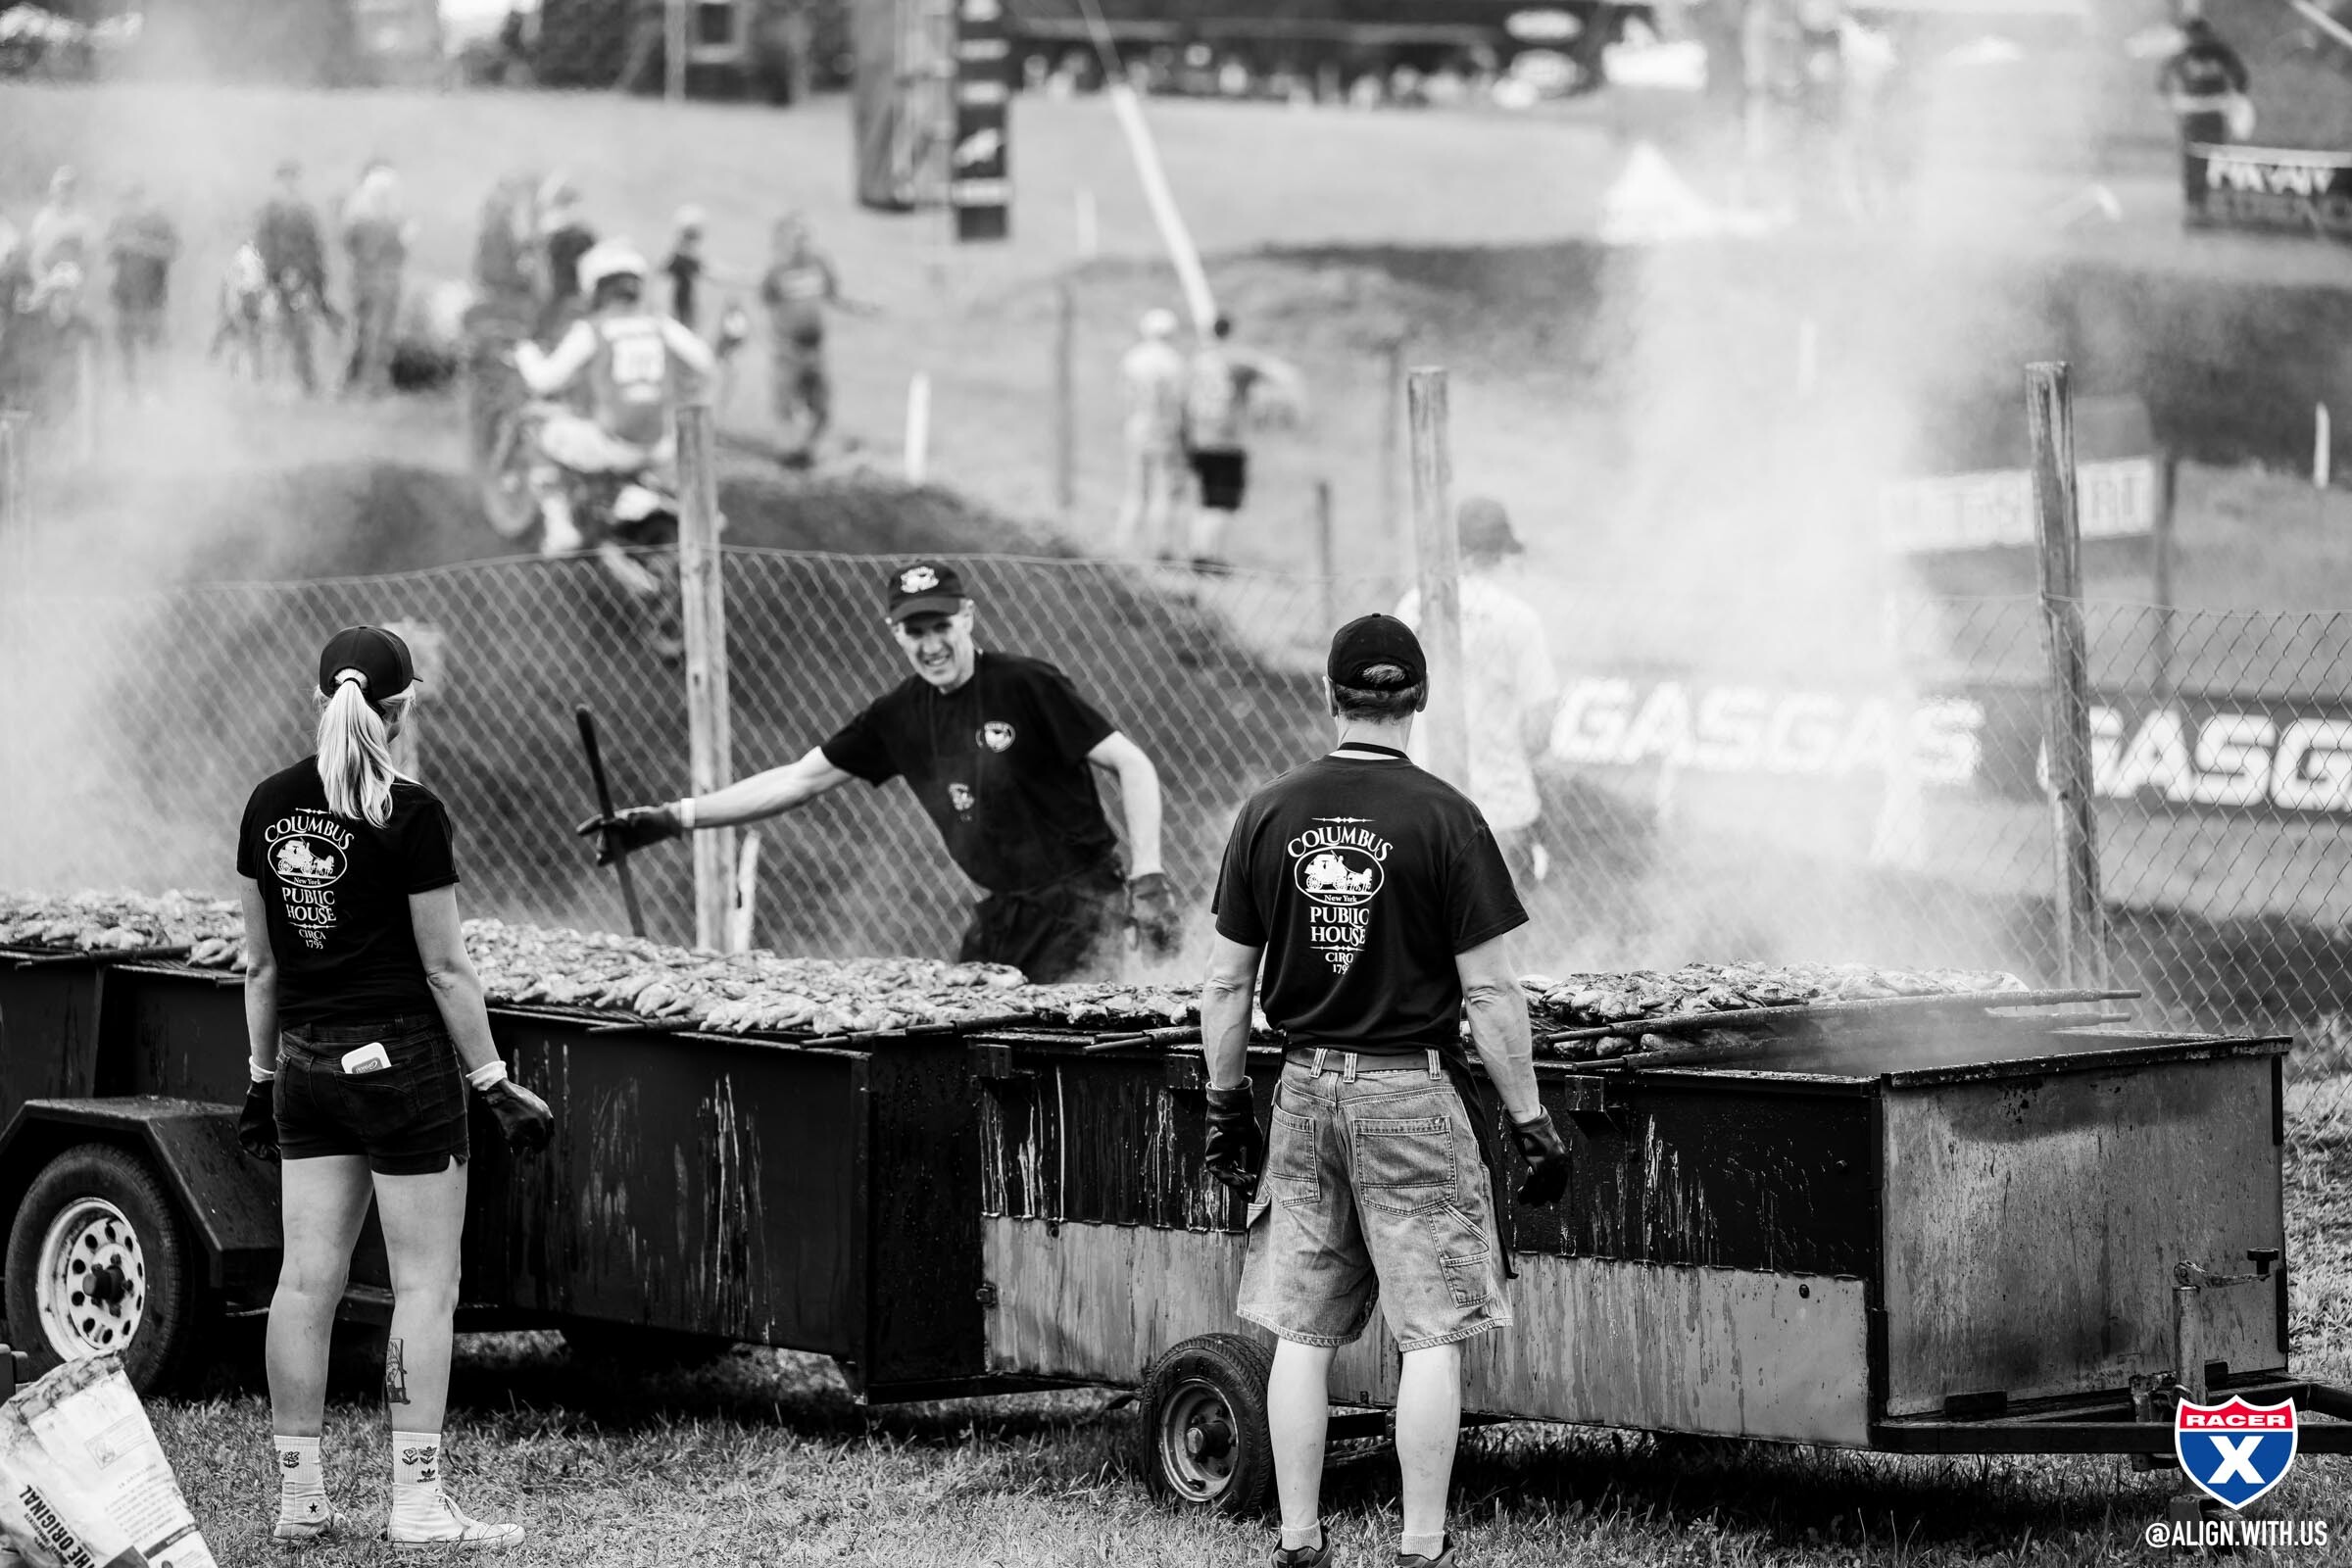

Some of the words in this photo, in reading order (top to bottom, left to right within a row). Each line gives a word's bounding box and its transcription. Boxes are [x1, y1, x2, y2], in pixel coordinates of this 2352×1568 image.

[1549, 676, 1984, 784] GASGAS
[265, 815, 355, 850] COLUMBUS
[1288, 825, 1394, 861] COLUMBUS
[282, 887, 335, 908] PUBLIC
[286, 904, 337, 924] HOUSE
[1310, 906, 1370, 928] PUBLIC
[298, 928, 326, 941] CIRCA
[306, 939, 323, 950] 1795
[1310, 926, 1366, 947] HOUSE
[1325, 952, 1354, 965] CIRC
[1333, 963, 1349, 974] 179
[19, 1485, 74, 1550] ORIGINAL
